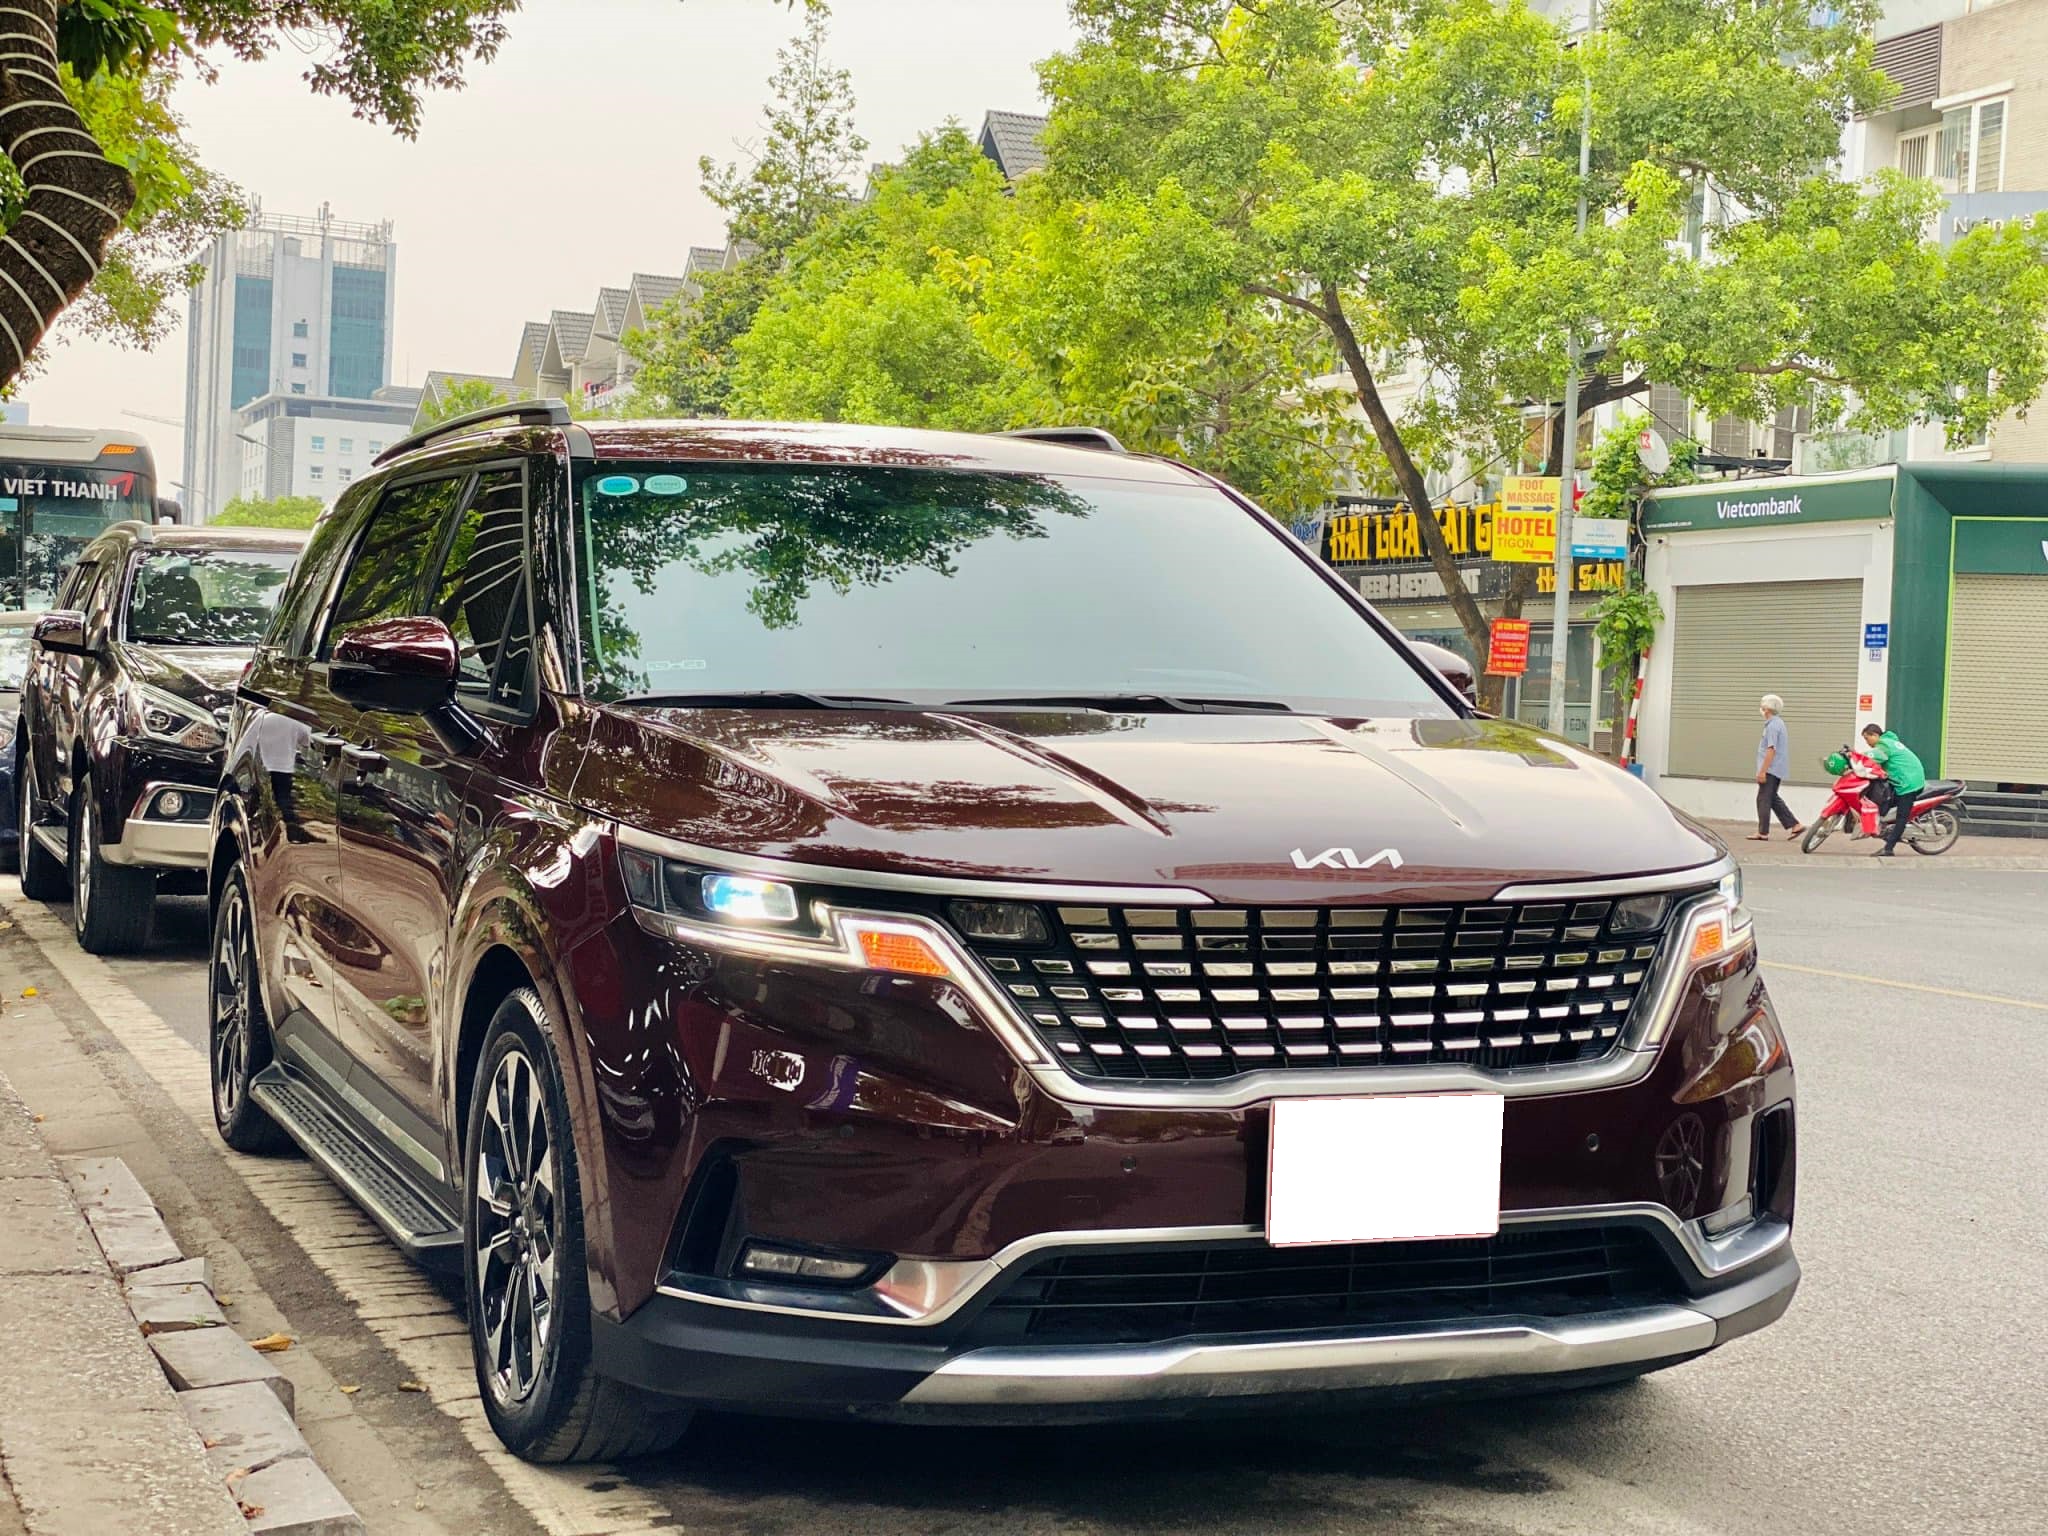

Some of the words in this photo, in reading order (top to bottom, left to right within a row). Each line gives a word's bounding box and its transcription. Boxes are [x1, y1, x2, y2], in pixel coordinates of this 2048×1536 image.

[52, 480, 118, 500] THANH
[1519, 479, 1544, 491] FOOT
[1506, 491, 1555, 504] MASSAGE
[1717, 495, 1801, 519] Vietcombank
[1496, 516, 1556, 537] HOTEL
[1330, 515, 1369, 560] HAI
[1497, 538, 1534, 549] TIGON
[1536, 566, 1574, 592] HI
[1290, 847, 1404, 870] KIA
